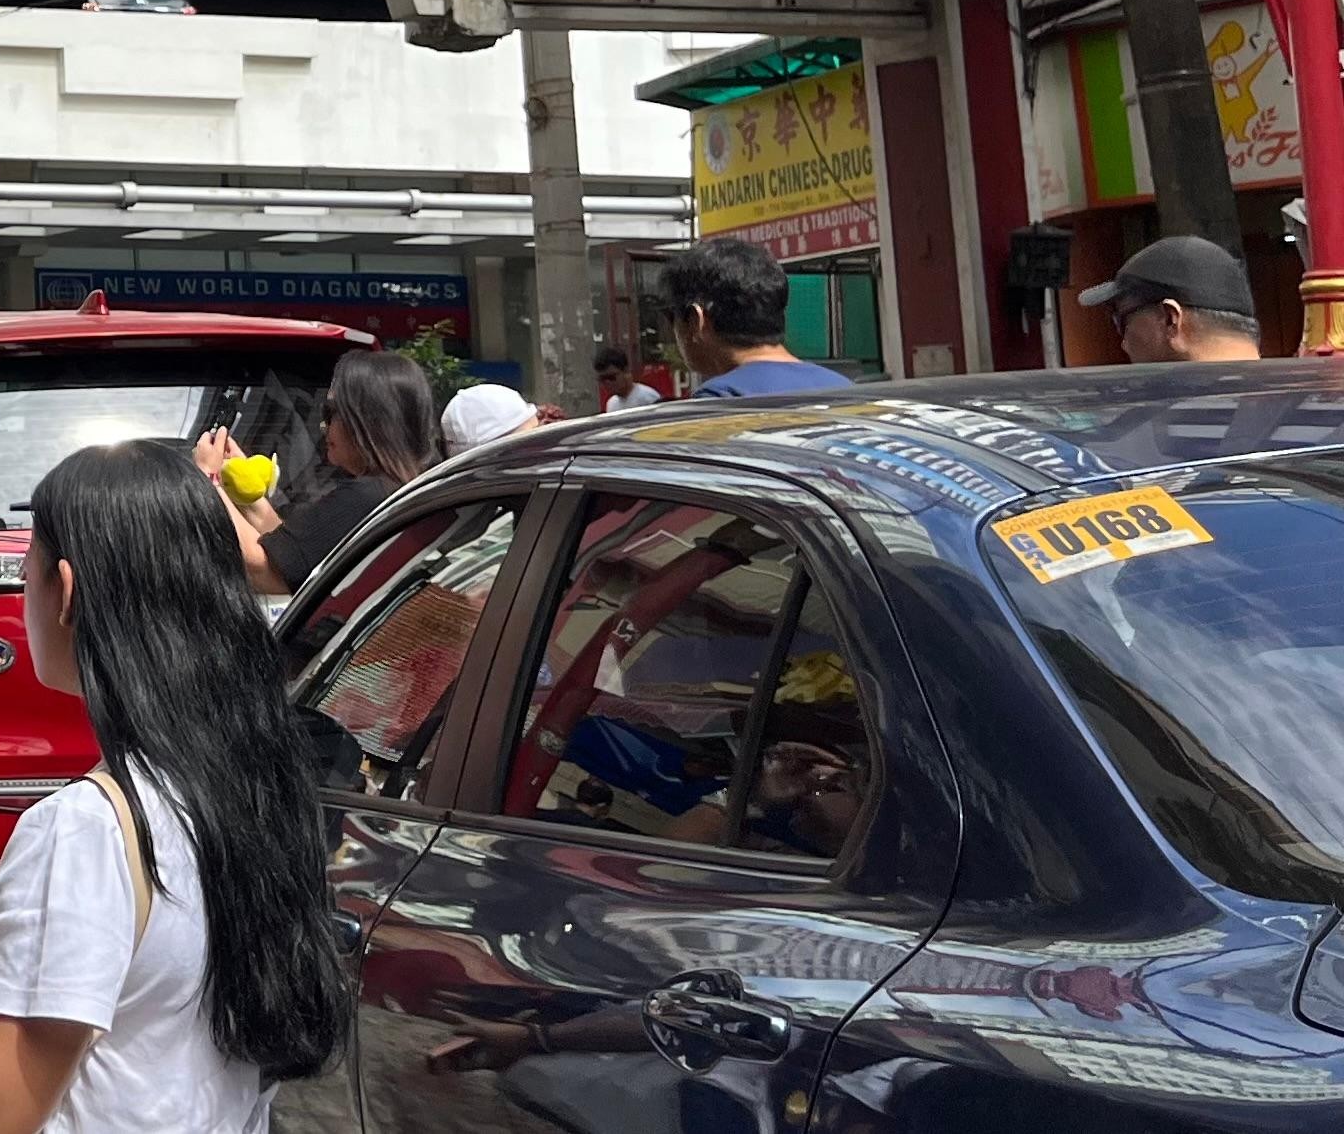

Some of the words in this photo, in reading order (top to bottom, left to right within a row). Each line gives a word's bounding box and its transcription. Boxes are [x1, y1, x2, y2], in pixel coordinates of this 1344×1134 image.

[701, 172, 766, 212] MANDARIN
[768, 156, 829, 197] CHINESE
[831, 145, 873, 183] DRUG
[810, 201, 877, 231] TRADITIONA
[104, 277, 161, 296] NEW
[176, 277, 270, 297] WORLD
[282, 278, 459, 300] DIAGNOCS
[1039, 504, 1172, 557] U168
